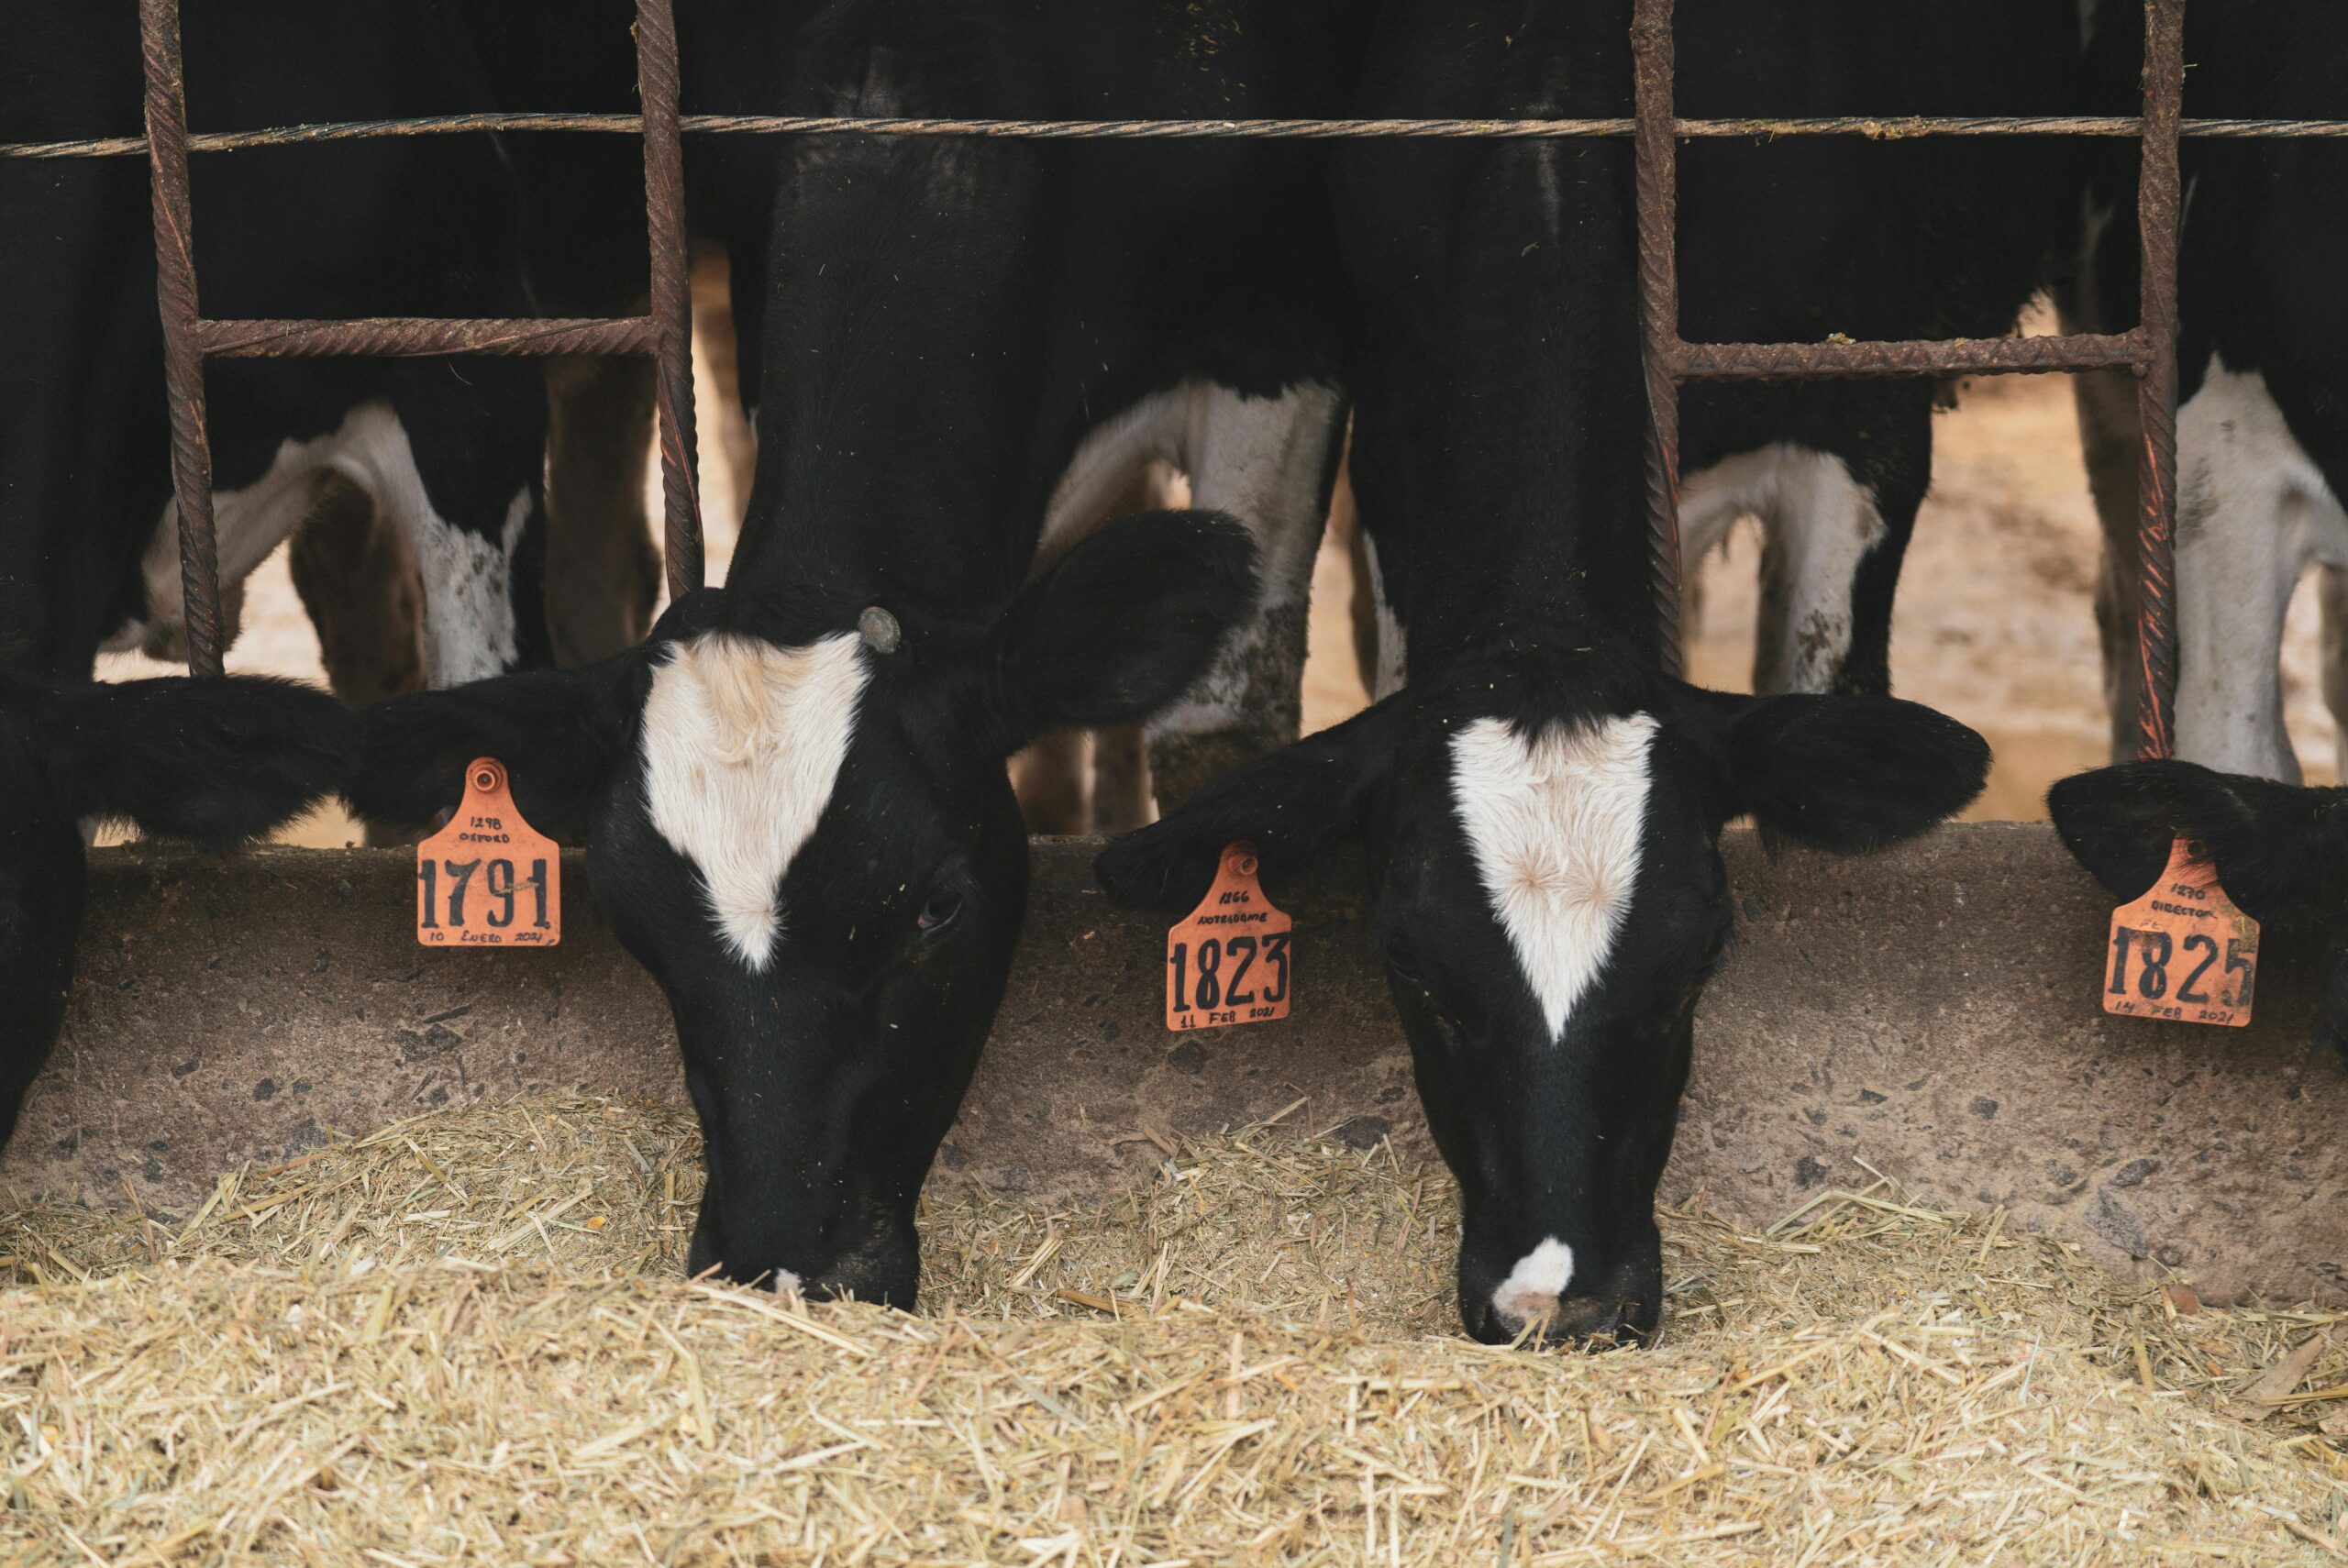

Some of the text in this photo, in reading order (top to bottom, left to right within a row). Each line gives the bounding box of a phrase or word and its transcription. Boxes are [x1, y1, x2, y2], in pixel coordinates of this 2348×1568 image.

[470, 816, 503, 830] 1298
[460, 833, 510, 844] OXFORD
[418, 858, 550, 929] 1791
[1219, 890, 1249, 904] 1266
[429, 930, 543, 944] 10 ENERO 2021
[1169, 931, 1291, 1012] 1823
[2108, 925, 2254, 1007] 1825
[1180, 1007, 1276, 1028] 11 FEB 2021
[2115, 1001, 2235, 1023] 14 FEB 2021
